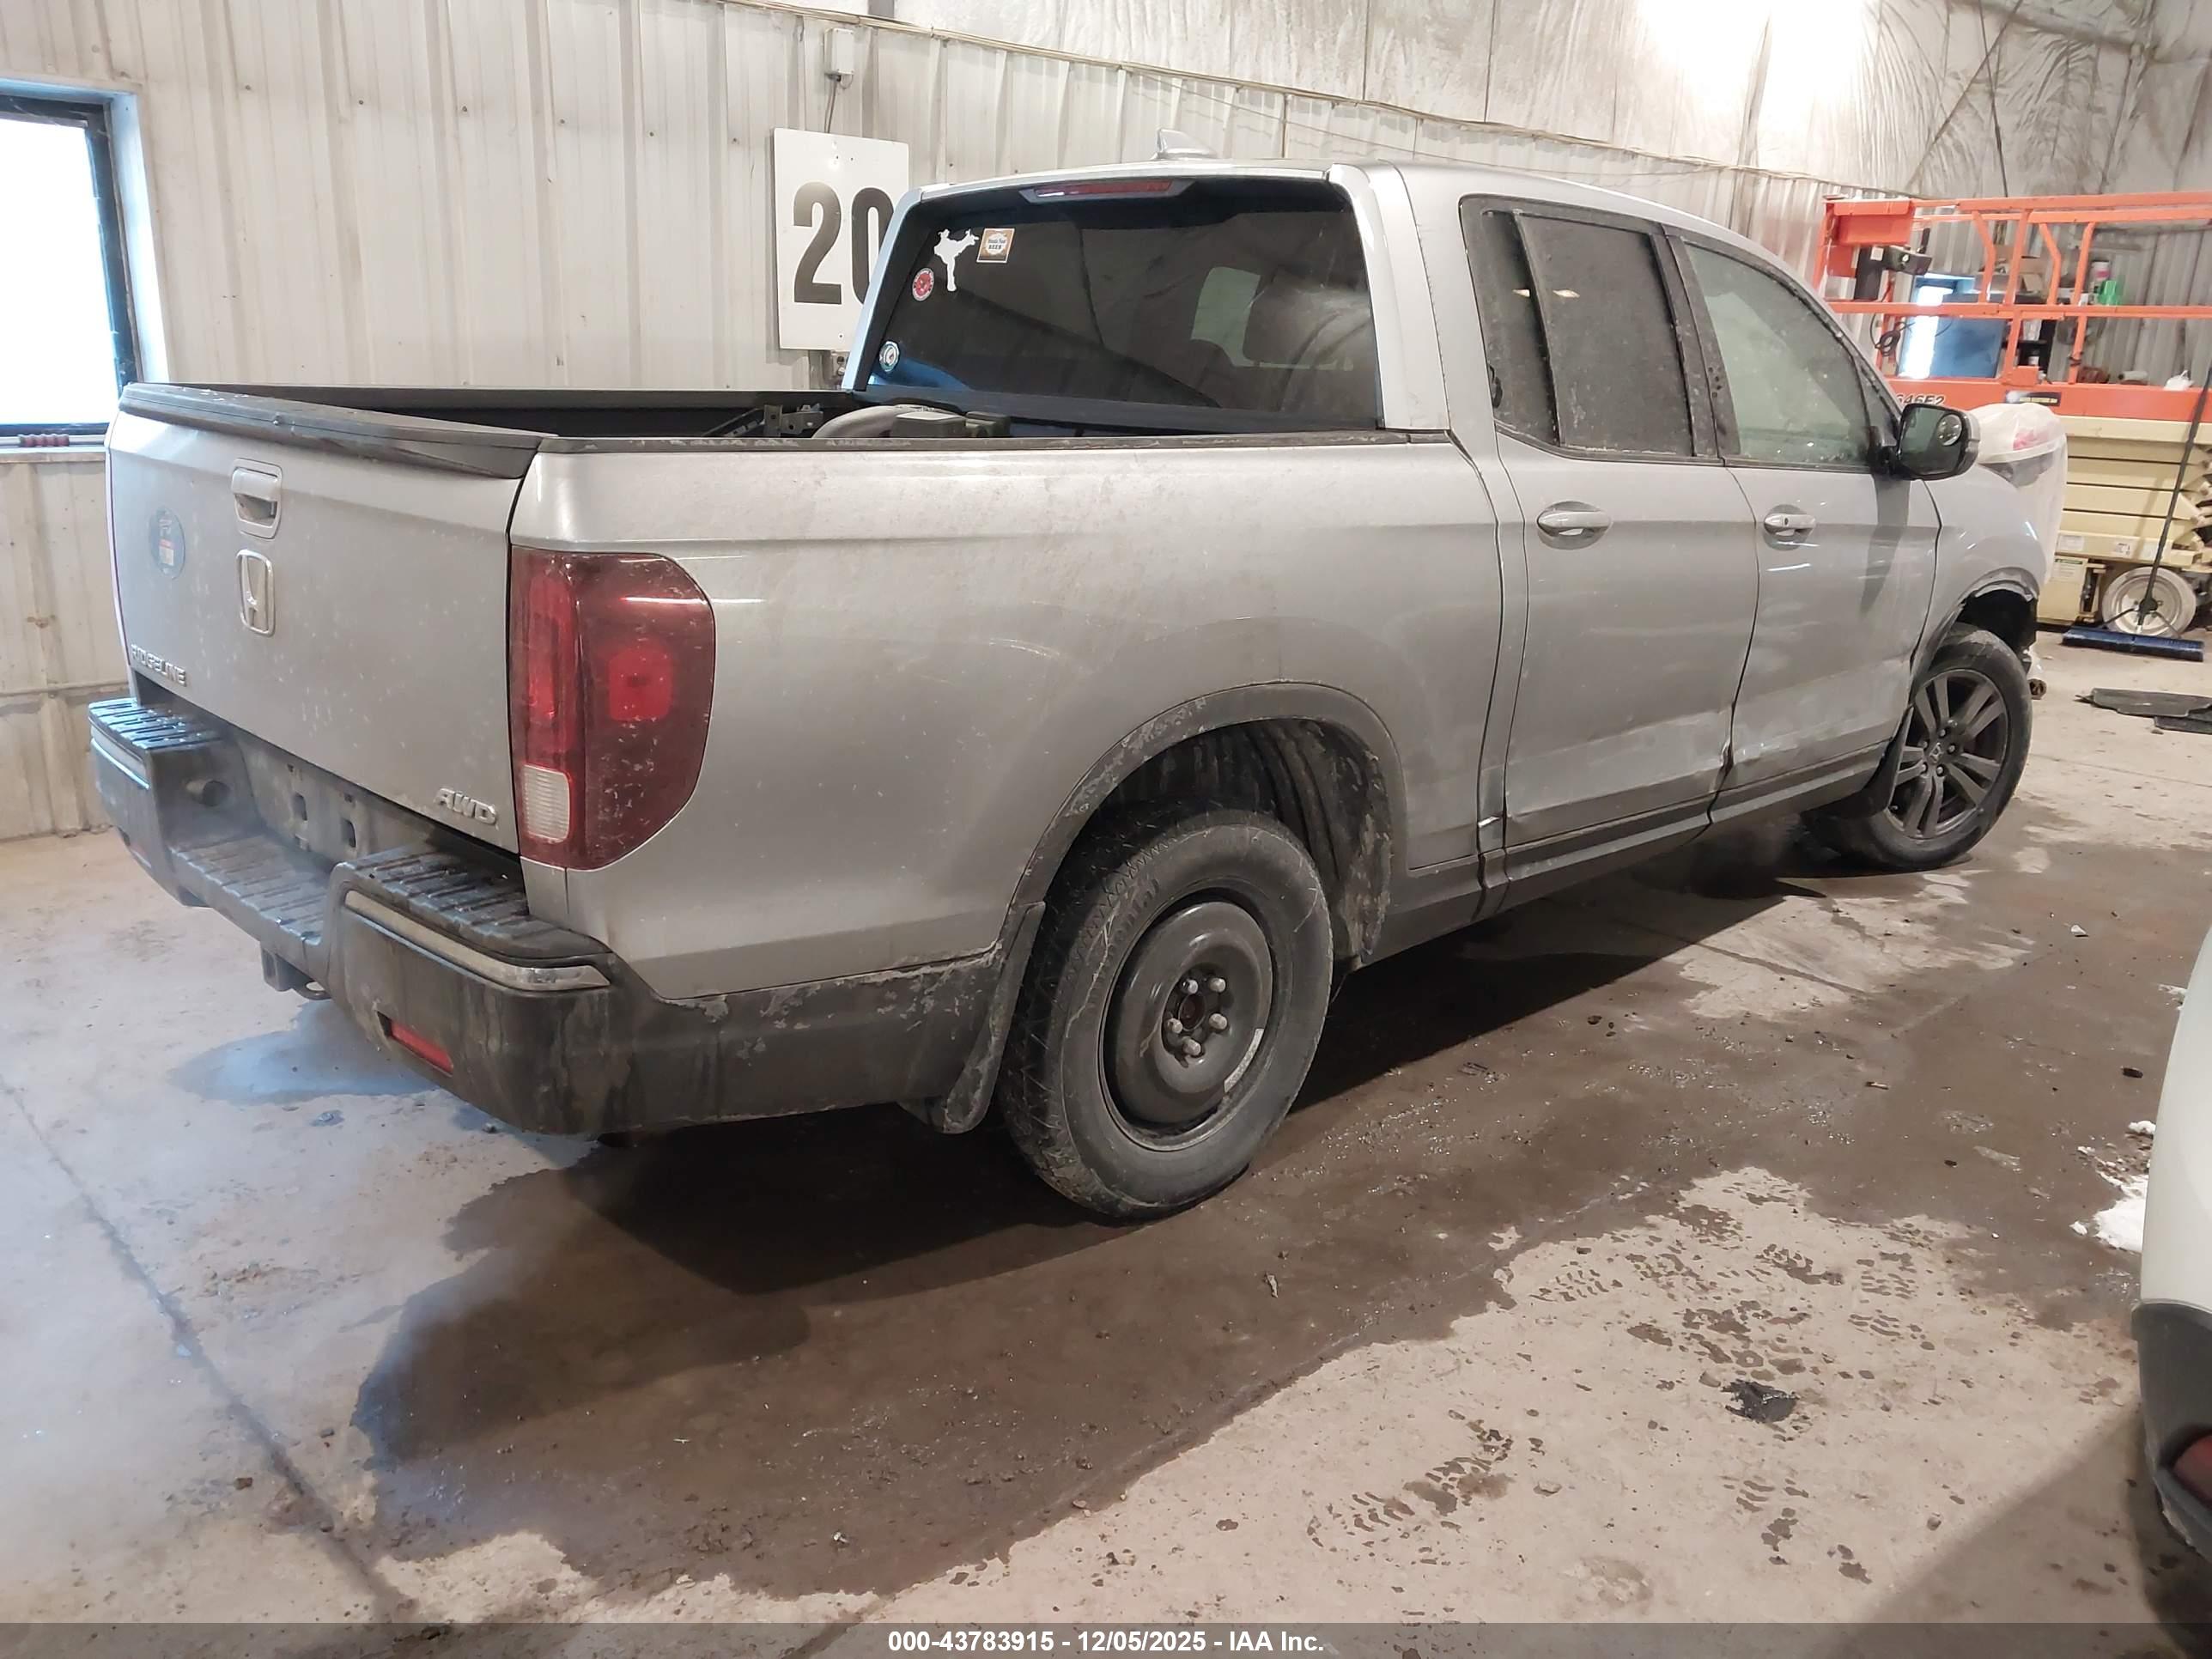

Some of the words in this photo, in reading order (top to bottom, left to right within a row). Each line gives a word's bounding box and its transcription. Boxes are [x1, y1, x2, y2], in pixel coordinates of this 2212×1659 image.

[793, 181, 894, 306] 20
[131, 643, 188, 688] RIDGELINE
[433, 787, 499, 825] AWD
